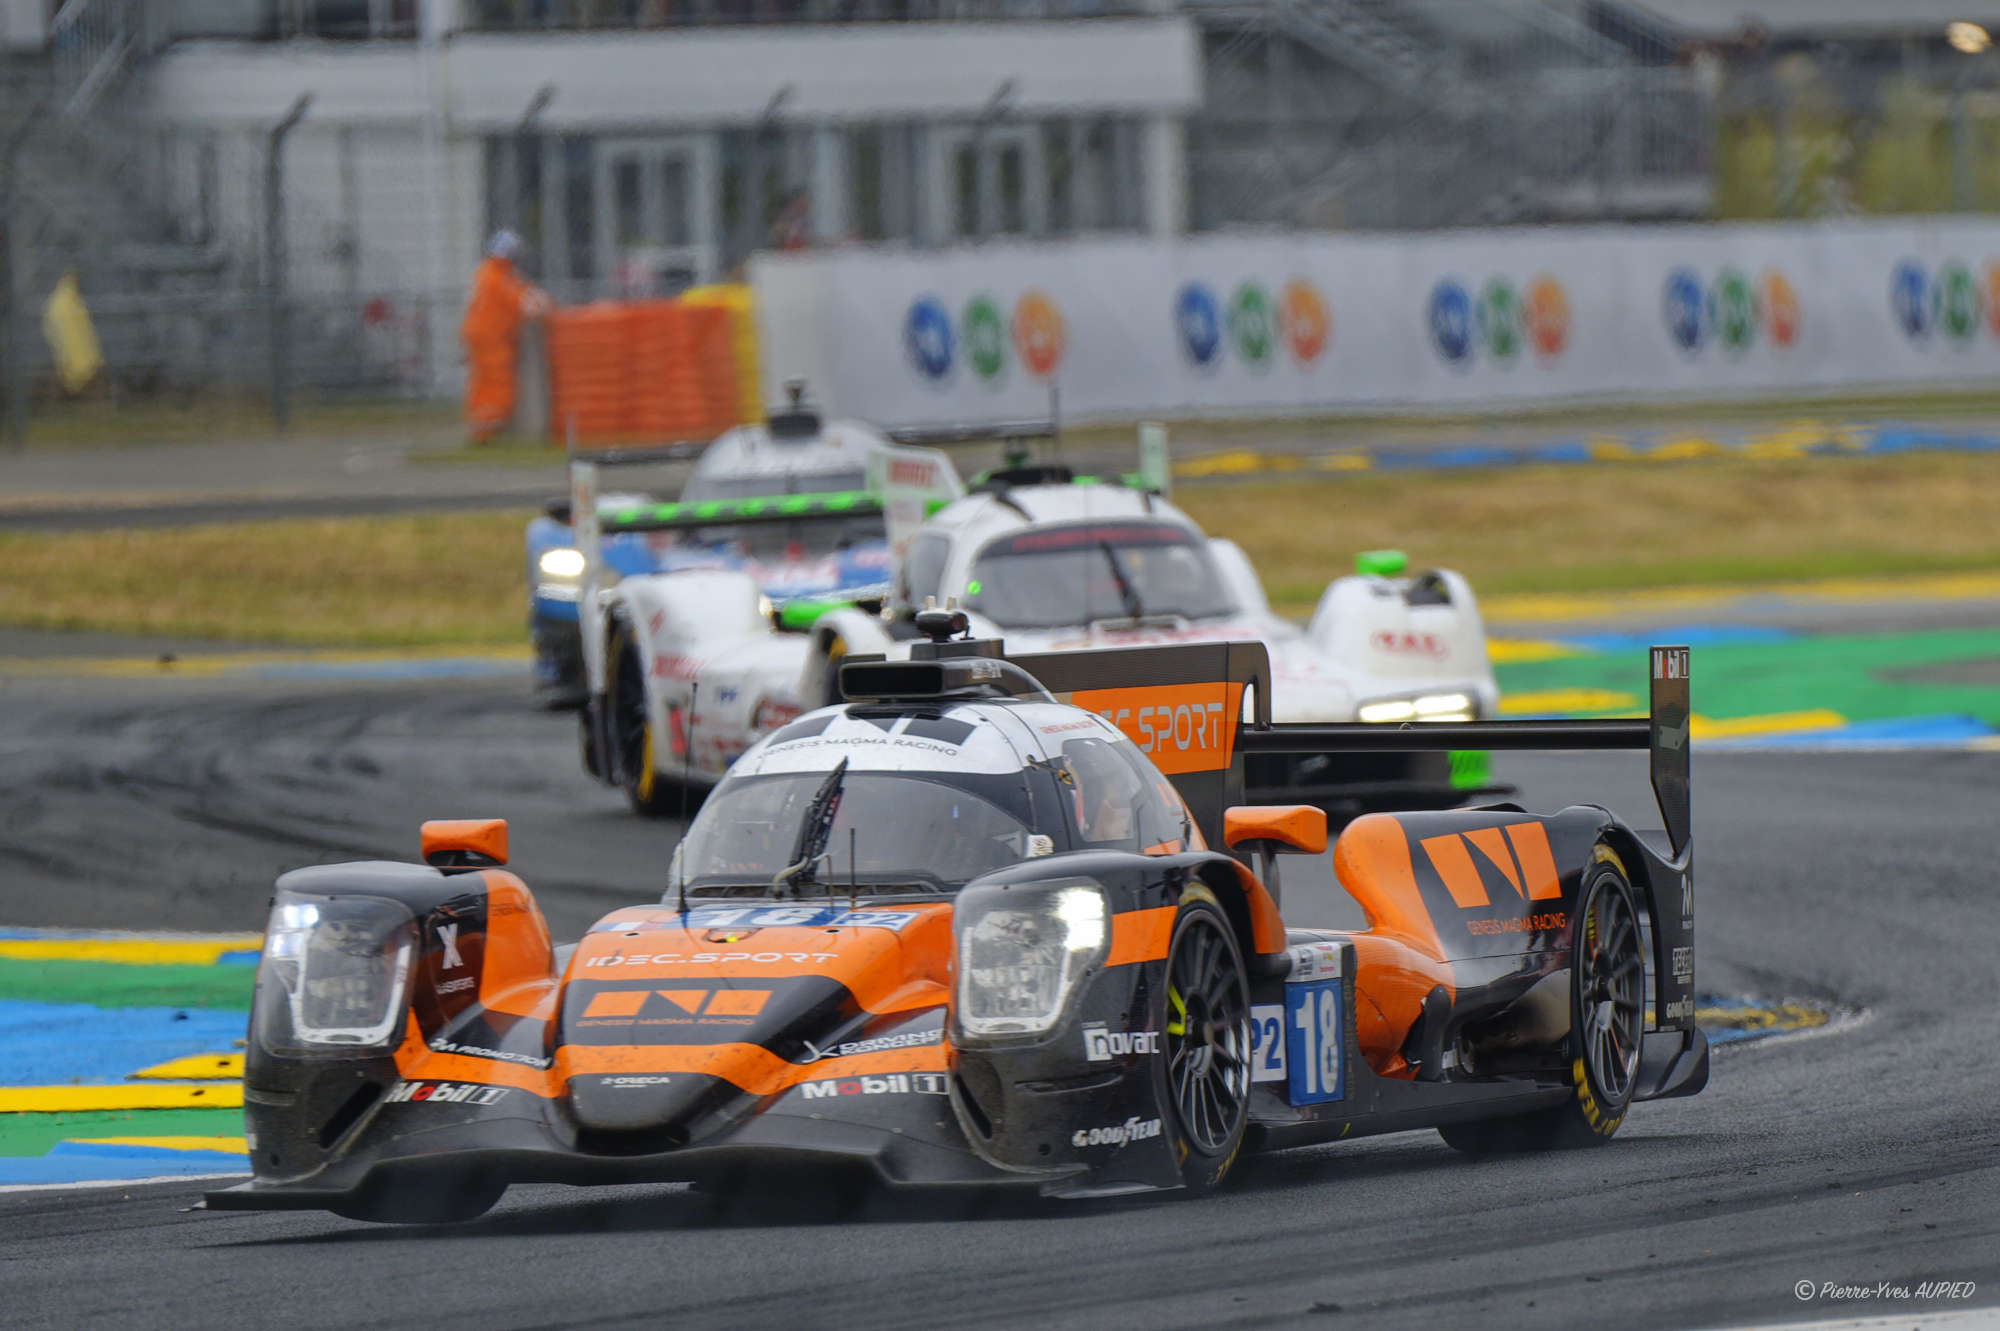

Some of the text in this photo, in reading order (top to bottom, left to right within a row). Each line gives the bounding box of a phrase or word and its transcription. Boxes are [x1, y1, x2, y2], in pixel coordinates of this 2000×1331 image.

[1138, 702, 1223, 753] SPORT
[820, 736, 887, 746] MAGMA
[892, 739, 958, 757] RACING
[703, 907, 902, 926] 18 P2
[1532, 912, 1567, 931] RACING
[1295, 989, 1339, 1094] 18
[384, 1082, 479, 1102] Mobil
[801, 1075, 909, 1099] Mobil
[1072, 1116, 1162, 1148] GOODYEAR
